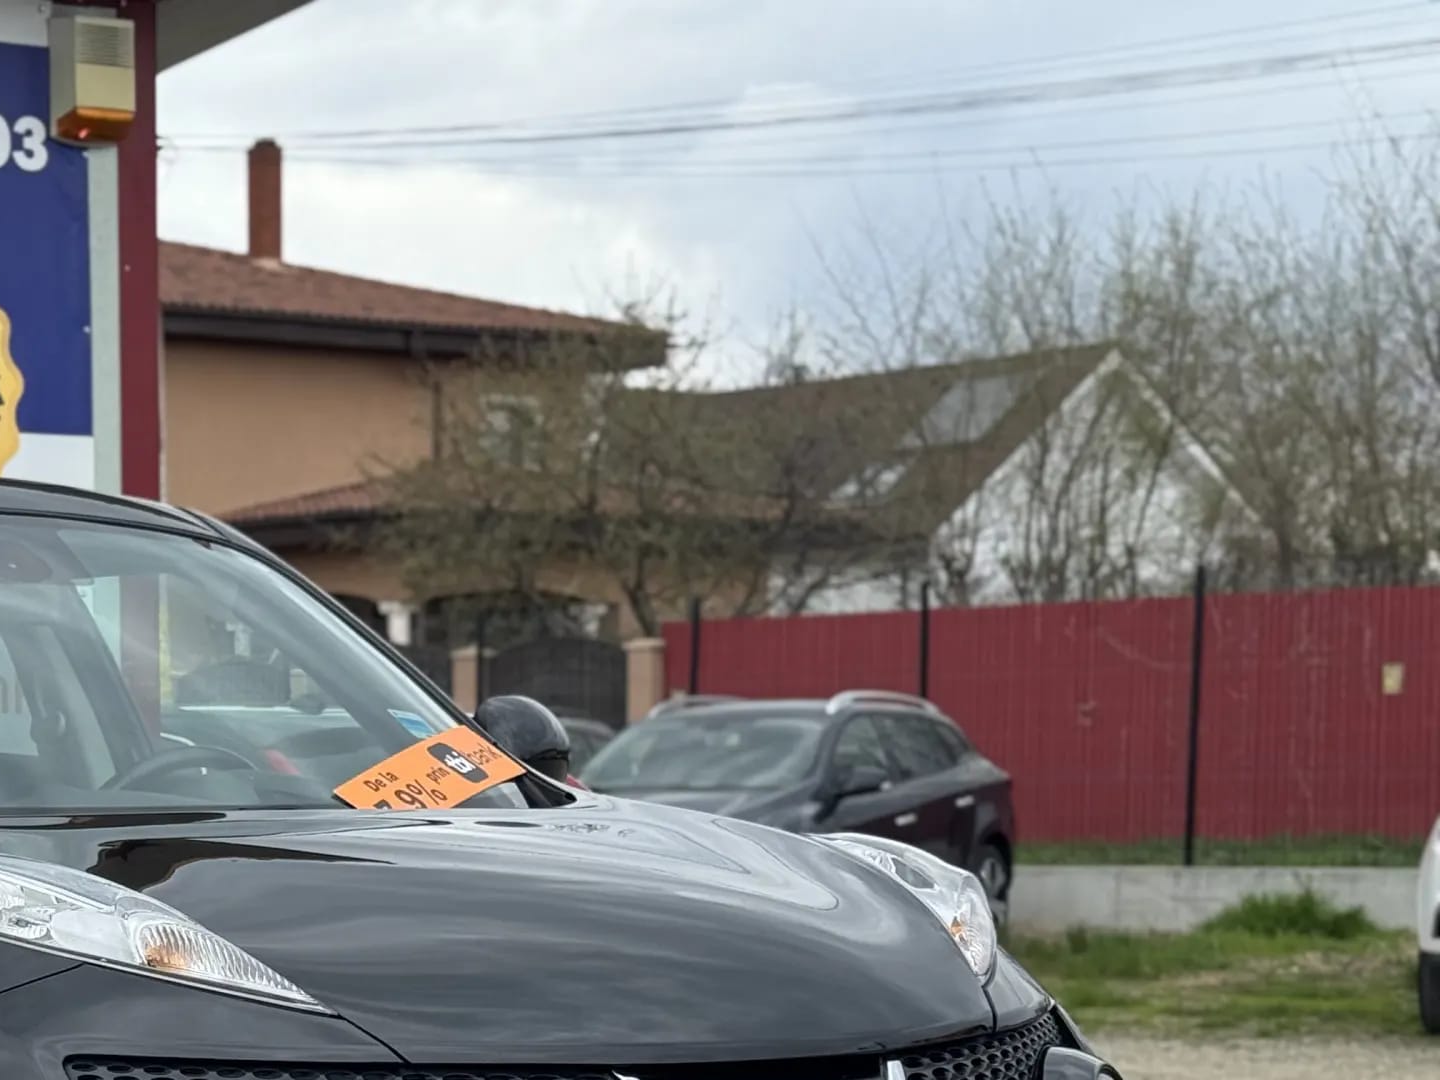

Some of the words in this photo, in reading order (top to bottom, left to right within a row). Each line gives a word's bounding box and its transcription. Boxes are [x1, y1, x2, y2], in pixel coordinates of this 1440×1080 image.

[363, 778, 387, 793] De
[378, 771, 400, 783] la
[426, 766, 451, 785] prin
